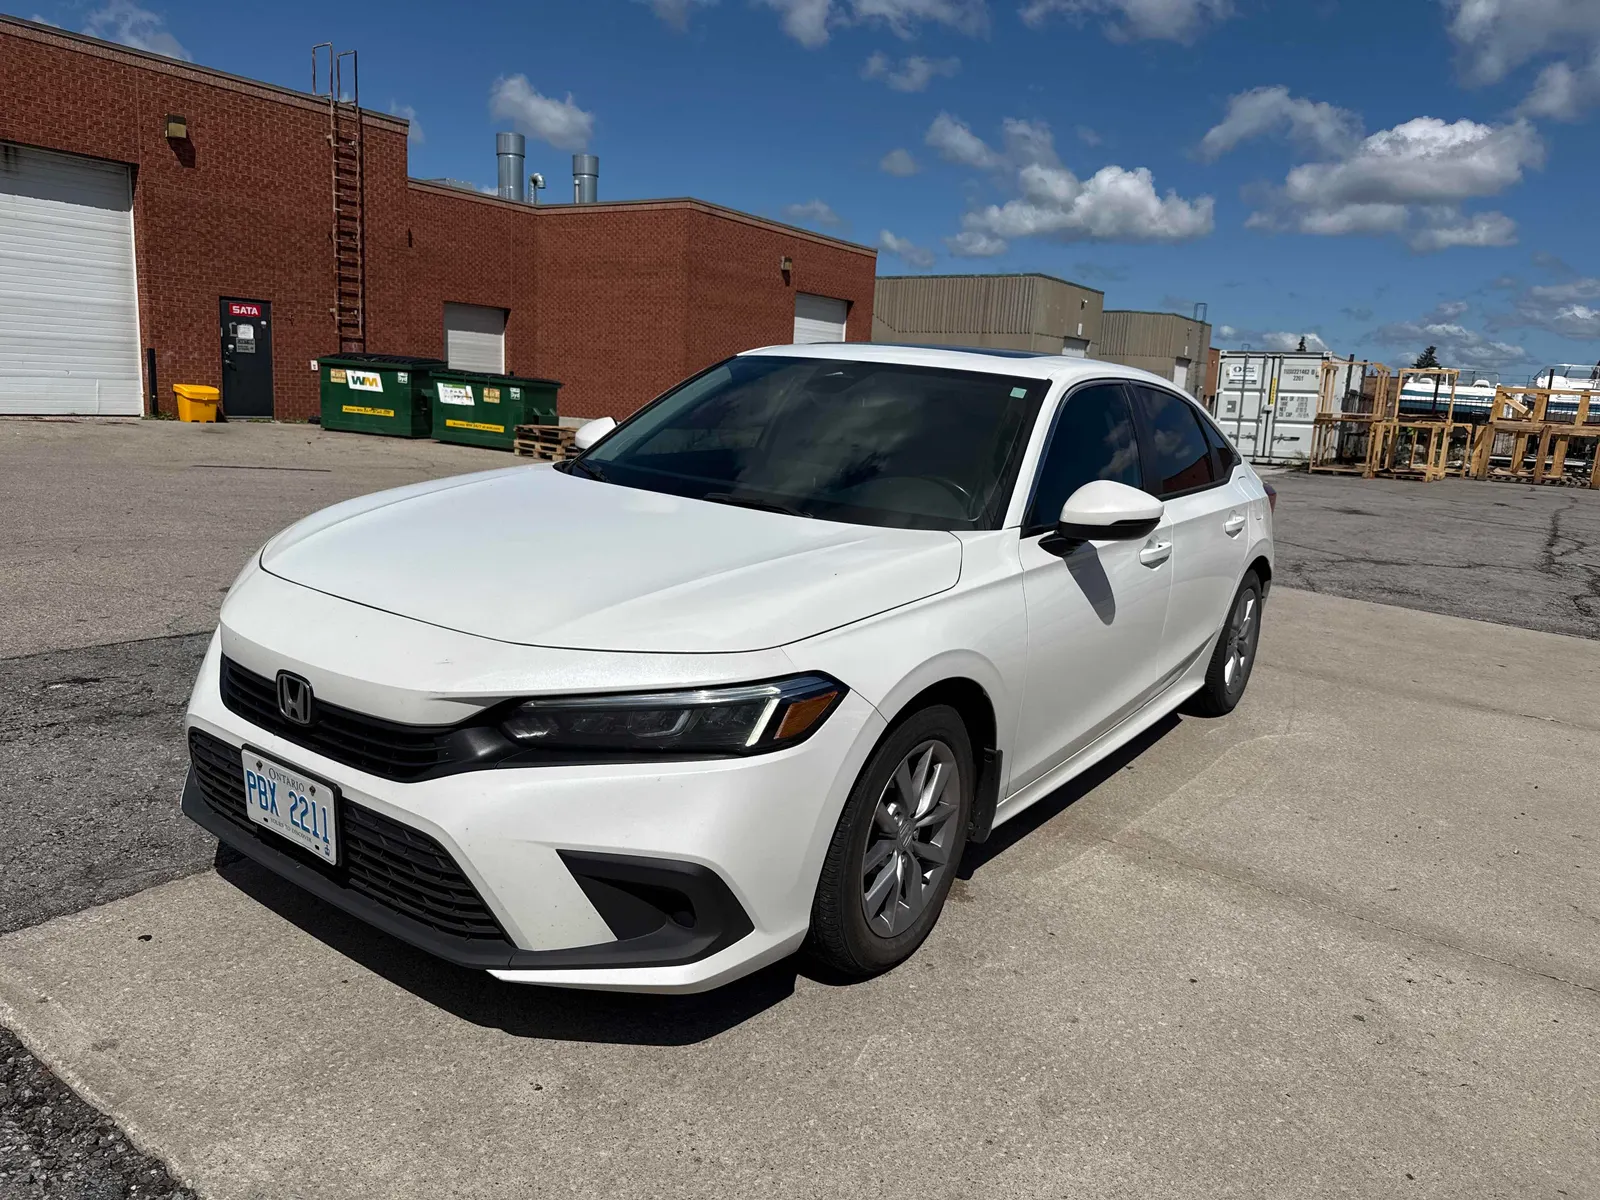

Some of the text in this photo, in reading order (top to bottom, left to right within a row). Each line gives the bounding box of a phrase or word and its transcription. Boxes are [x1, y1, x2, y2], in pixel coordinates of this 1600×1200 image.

[232, 305, 258, 315] SATA
[351, 375, 378, 387] WM
[268, 767, 305, 792] ONTARIO
[246, 769, 330, 844] PBX 2211
